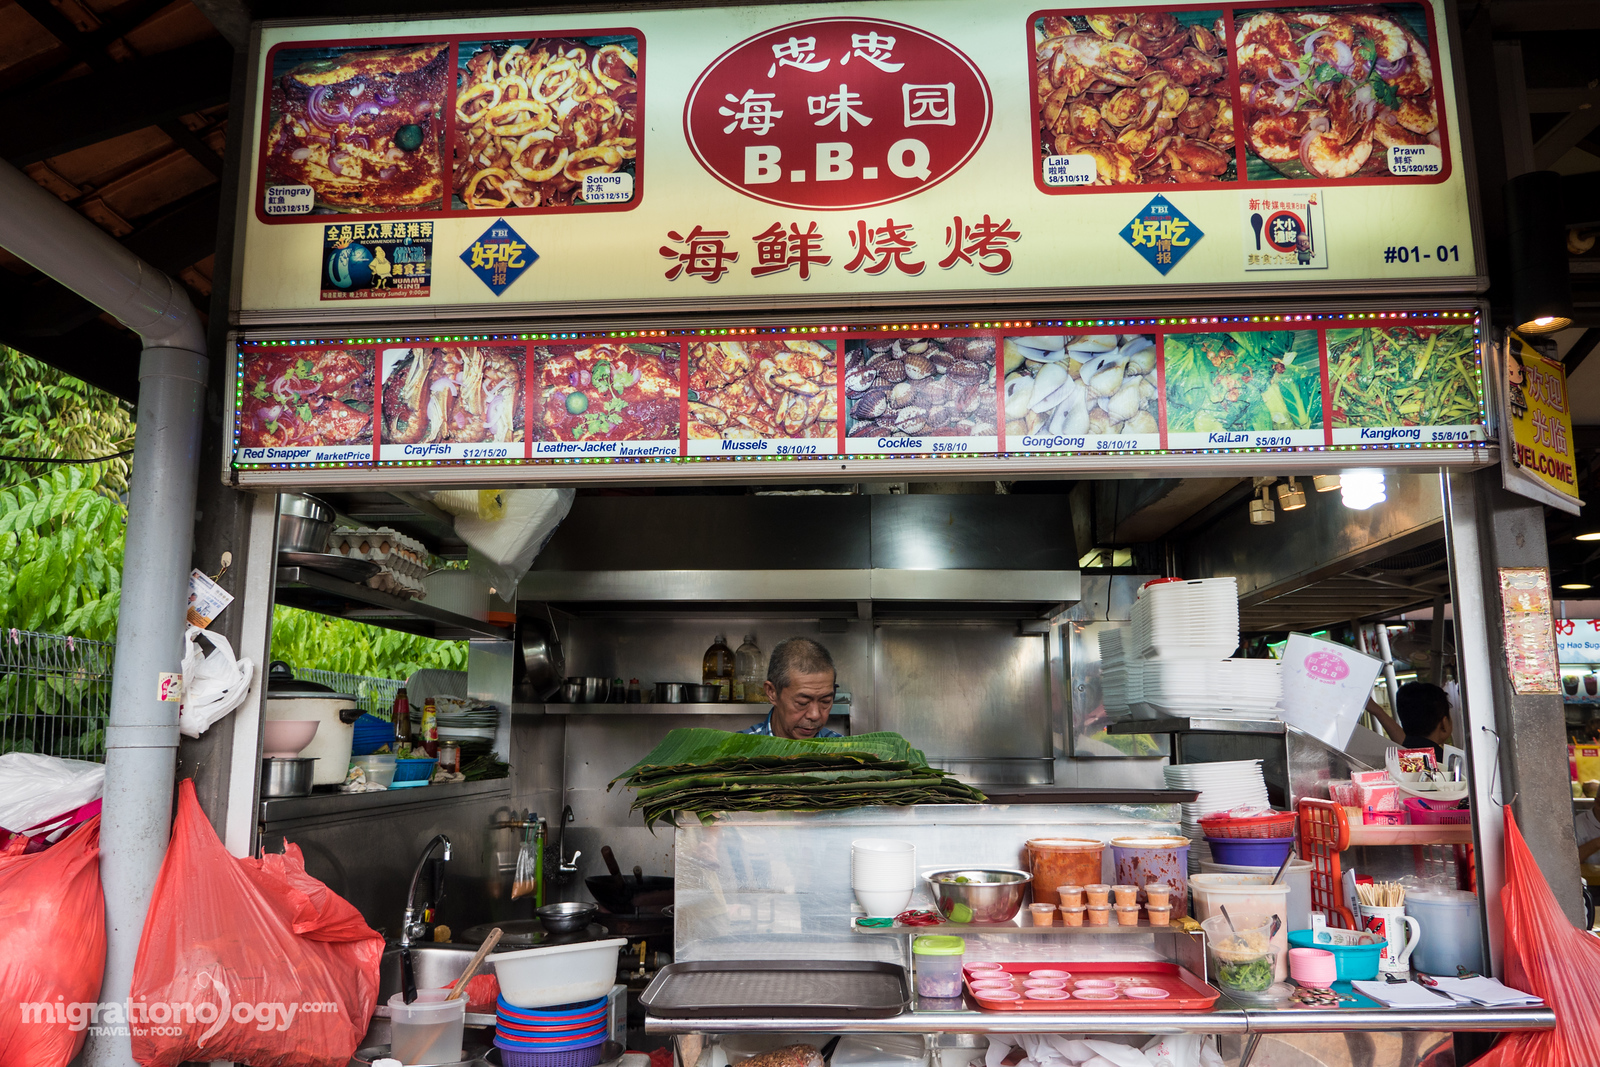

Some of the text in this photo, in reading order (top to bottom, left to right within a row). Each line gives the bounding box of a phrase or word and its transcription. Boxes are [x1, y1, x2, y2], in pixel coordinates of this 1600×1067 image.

[767, 31, 906, 79] 忠忠
[718, 82, 957, 136] 海味园
[1393, 147, 1426, 155] Prawn
[743, 138, 932, 185] B.B.Q
[1048, 157, 1070, 166] Lala
[1392, 164, 1439, 173] $15/$20/$25
[586, 175, 621, 185] Sotong
[1049, 174, 1090, 183] $8/$10/$12
[268, 187, 312, 198] Stringray
[585, 192, 630, 201] $10/$12/$15
[268, 204, 310, 213] $10/$12/$15
[1151, 205, 1169, 214] FBI
[327, 222, 433, 242] 全岛民众票选推荐
[491, 229, 509, 237] FBI
[1131, 217, 1191, 248] 好吃
[470, 240, 527, 270] 好吃
[658, 213, 1022, 284] 海鲜烧烤
[392, 263, 426, 276] 美食王
[1526, 364, 1564, 414] 欢迎
[1208, 432, 1291, 446] KaiLan $5/8/10
[1360, 427, 1468, 441] Kangkong $5/8/10
[1532, 408, 1568, 457] 光临
[536, 442, 677, 456] Leather-Jacket MarketPrice
[721, 439, 817, 454] Mussels $8/10/12
[877, 437, 968, 452] Cockles $5/8/10
[1022, 436, 1138, 450] GongGong $8/10/12
[243, 447, 371, 461] Red Snapper MarketPrice
[404, 444, 507, 458] CrayFish $12/15/20
[1516, 442, 1574, 485] WELCOME
